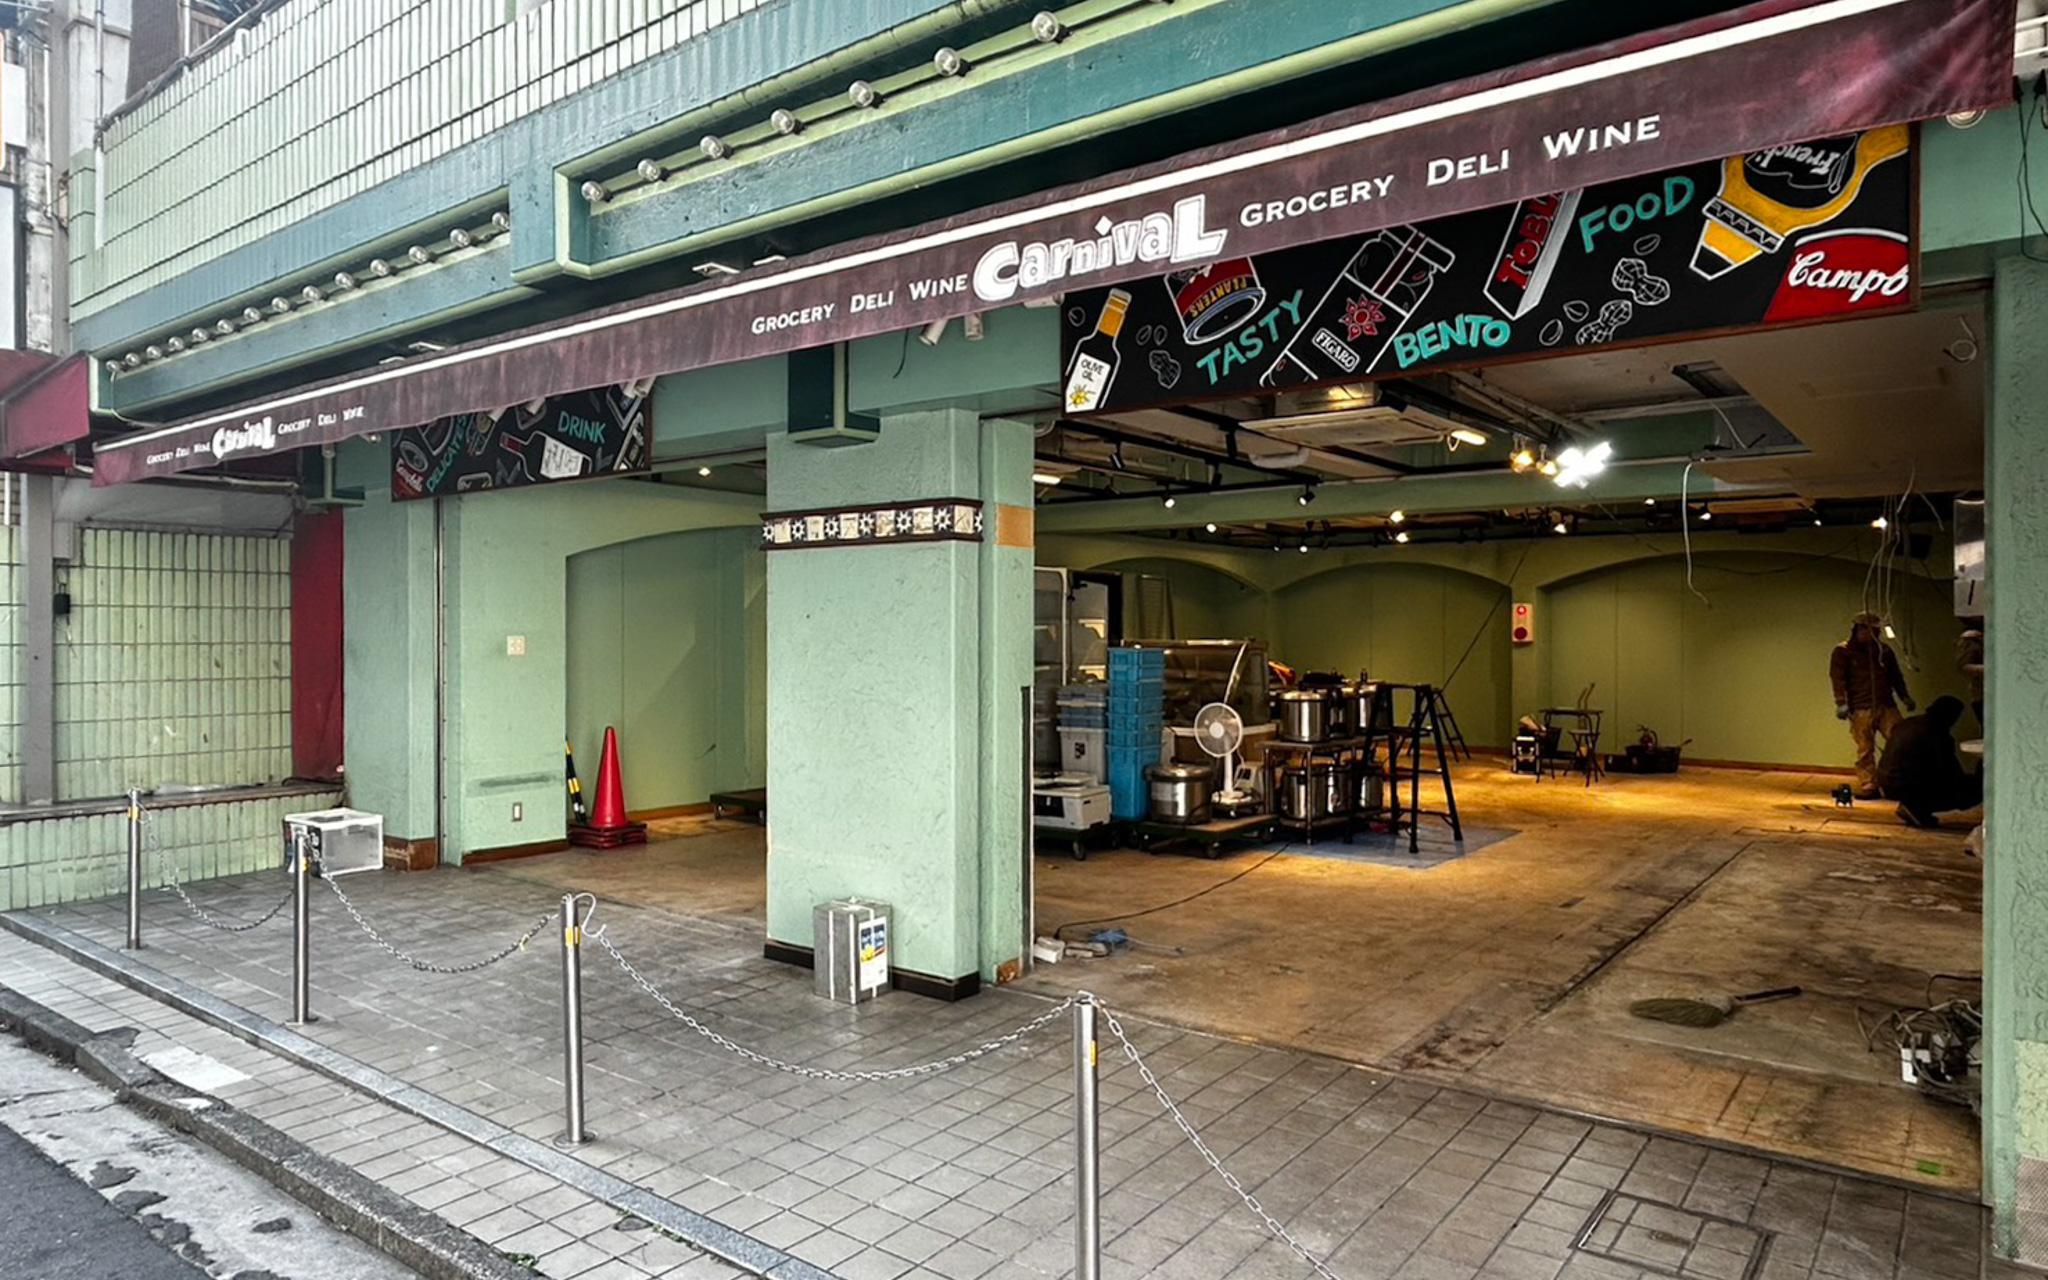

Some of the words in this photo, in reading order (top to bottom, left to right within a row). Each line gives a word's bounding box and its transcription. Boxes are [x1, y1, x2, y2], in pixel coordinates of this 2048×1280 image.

[752, 303, 835, 336] GROCERY
[850, 290, 894, 314] DELI
[908, 273, 968, 301] WINE
[1239, 174, 1395, 228] GROCERY
[1426, 149, 1510, 187] DELI
[1542, 115, 1661, 161] WINE
[1578, 175, 1696, 254] FOOD
[1188, 275, 1248, 319] PLANTERS
[1196, 288, 1304, 385] TASTY
[1315, 331, 1356, 369] FIGARO
[1392, 312, 1512, 369] BENTO
[557, 410, 607, 444] DRINK
